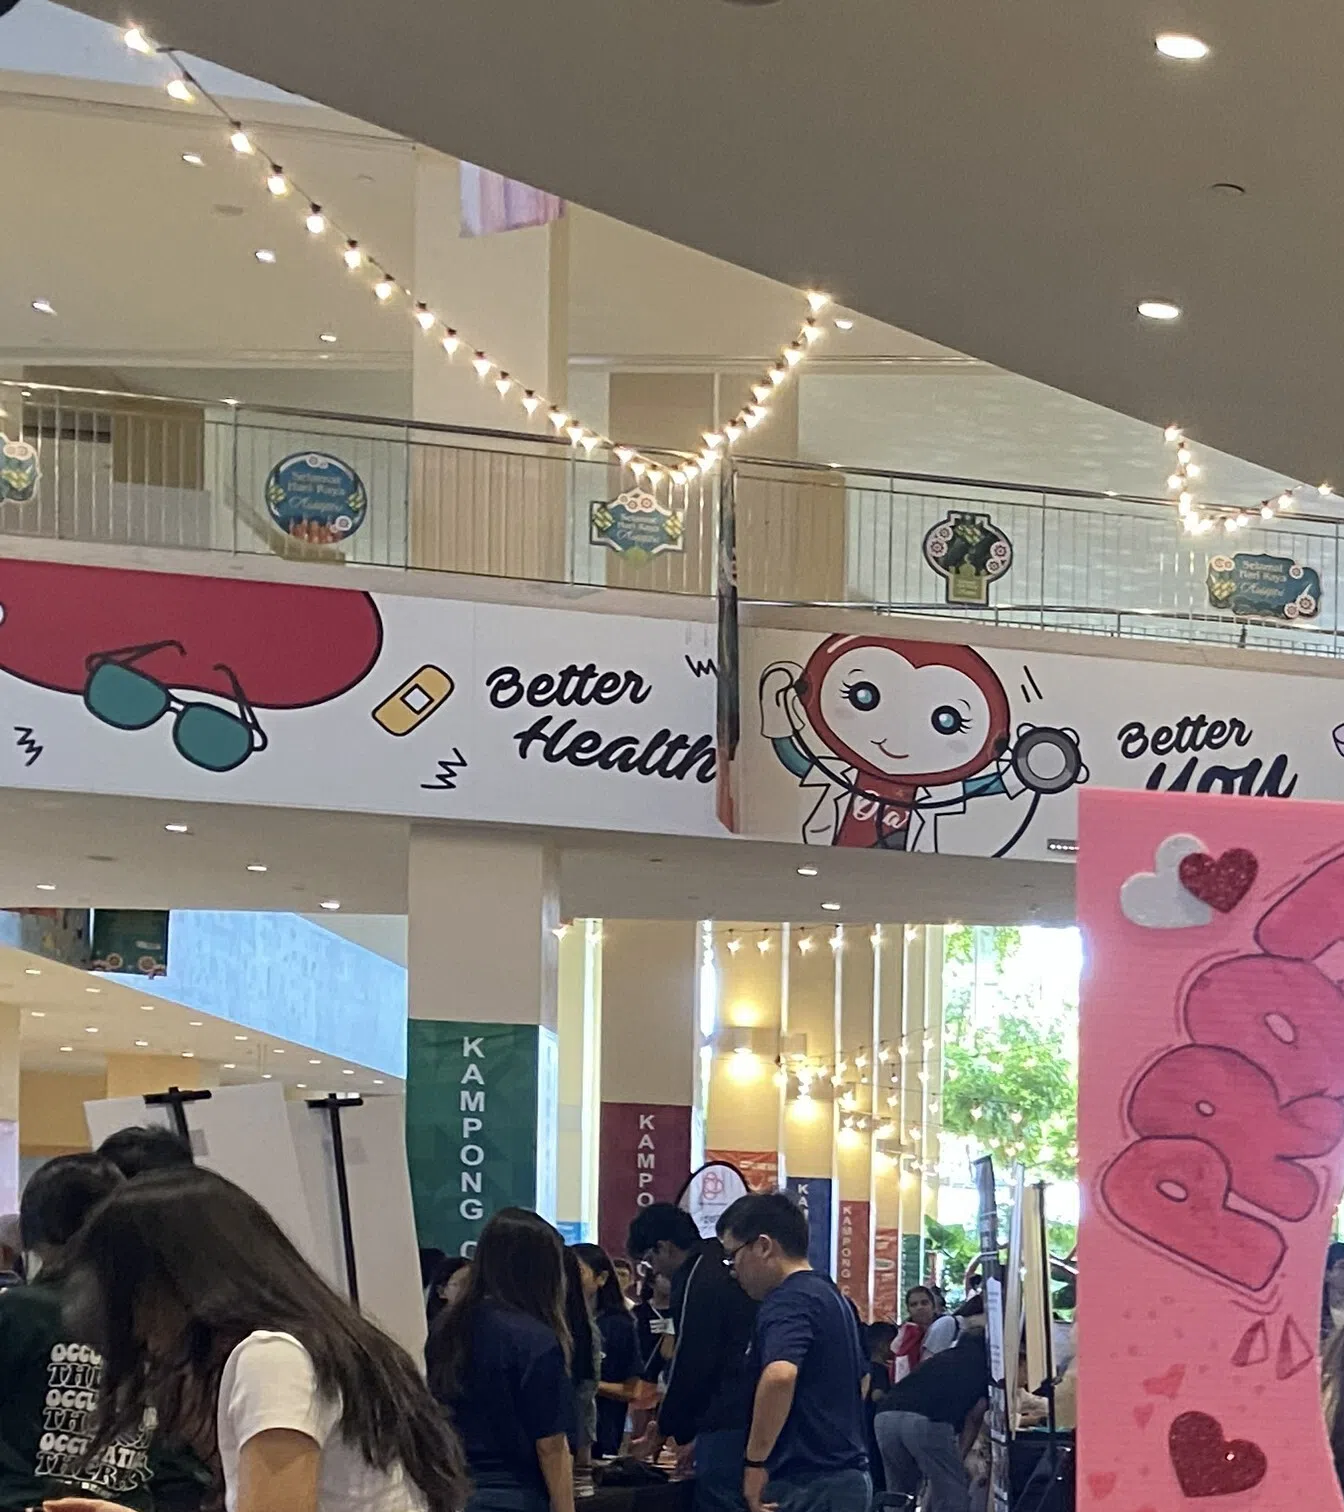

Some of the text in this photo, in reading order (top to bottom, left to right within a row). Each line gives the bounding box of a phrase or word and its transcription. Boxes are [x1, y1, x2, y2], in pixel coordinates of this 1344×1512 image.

[486, 663, 652, 708] Better
[513, 715, 718, 784] Health
[1117, 714, 1253, 759] Better
[458, 1036, 486, 1221] KAMPONG
[636, 1114, 656, 1208] KAMPO
[50, 1343, 102, 1365] OCCU
[45, 1389, 98, 1412] OCCU
